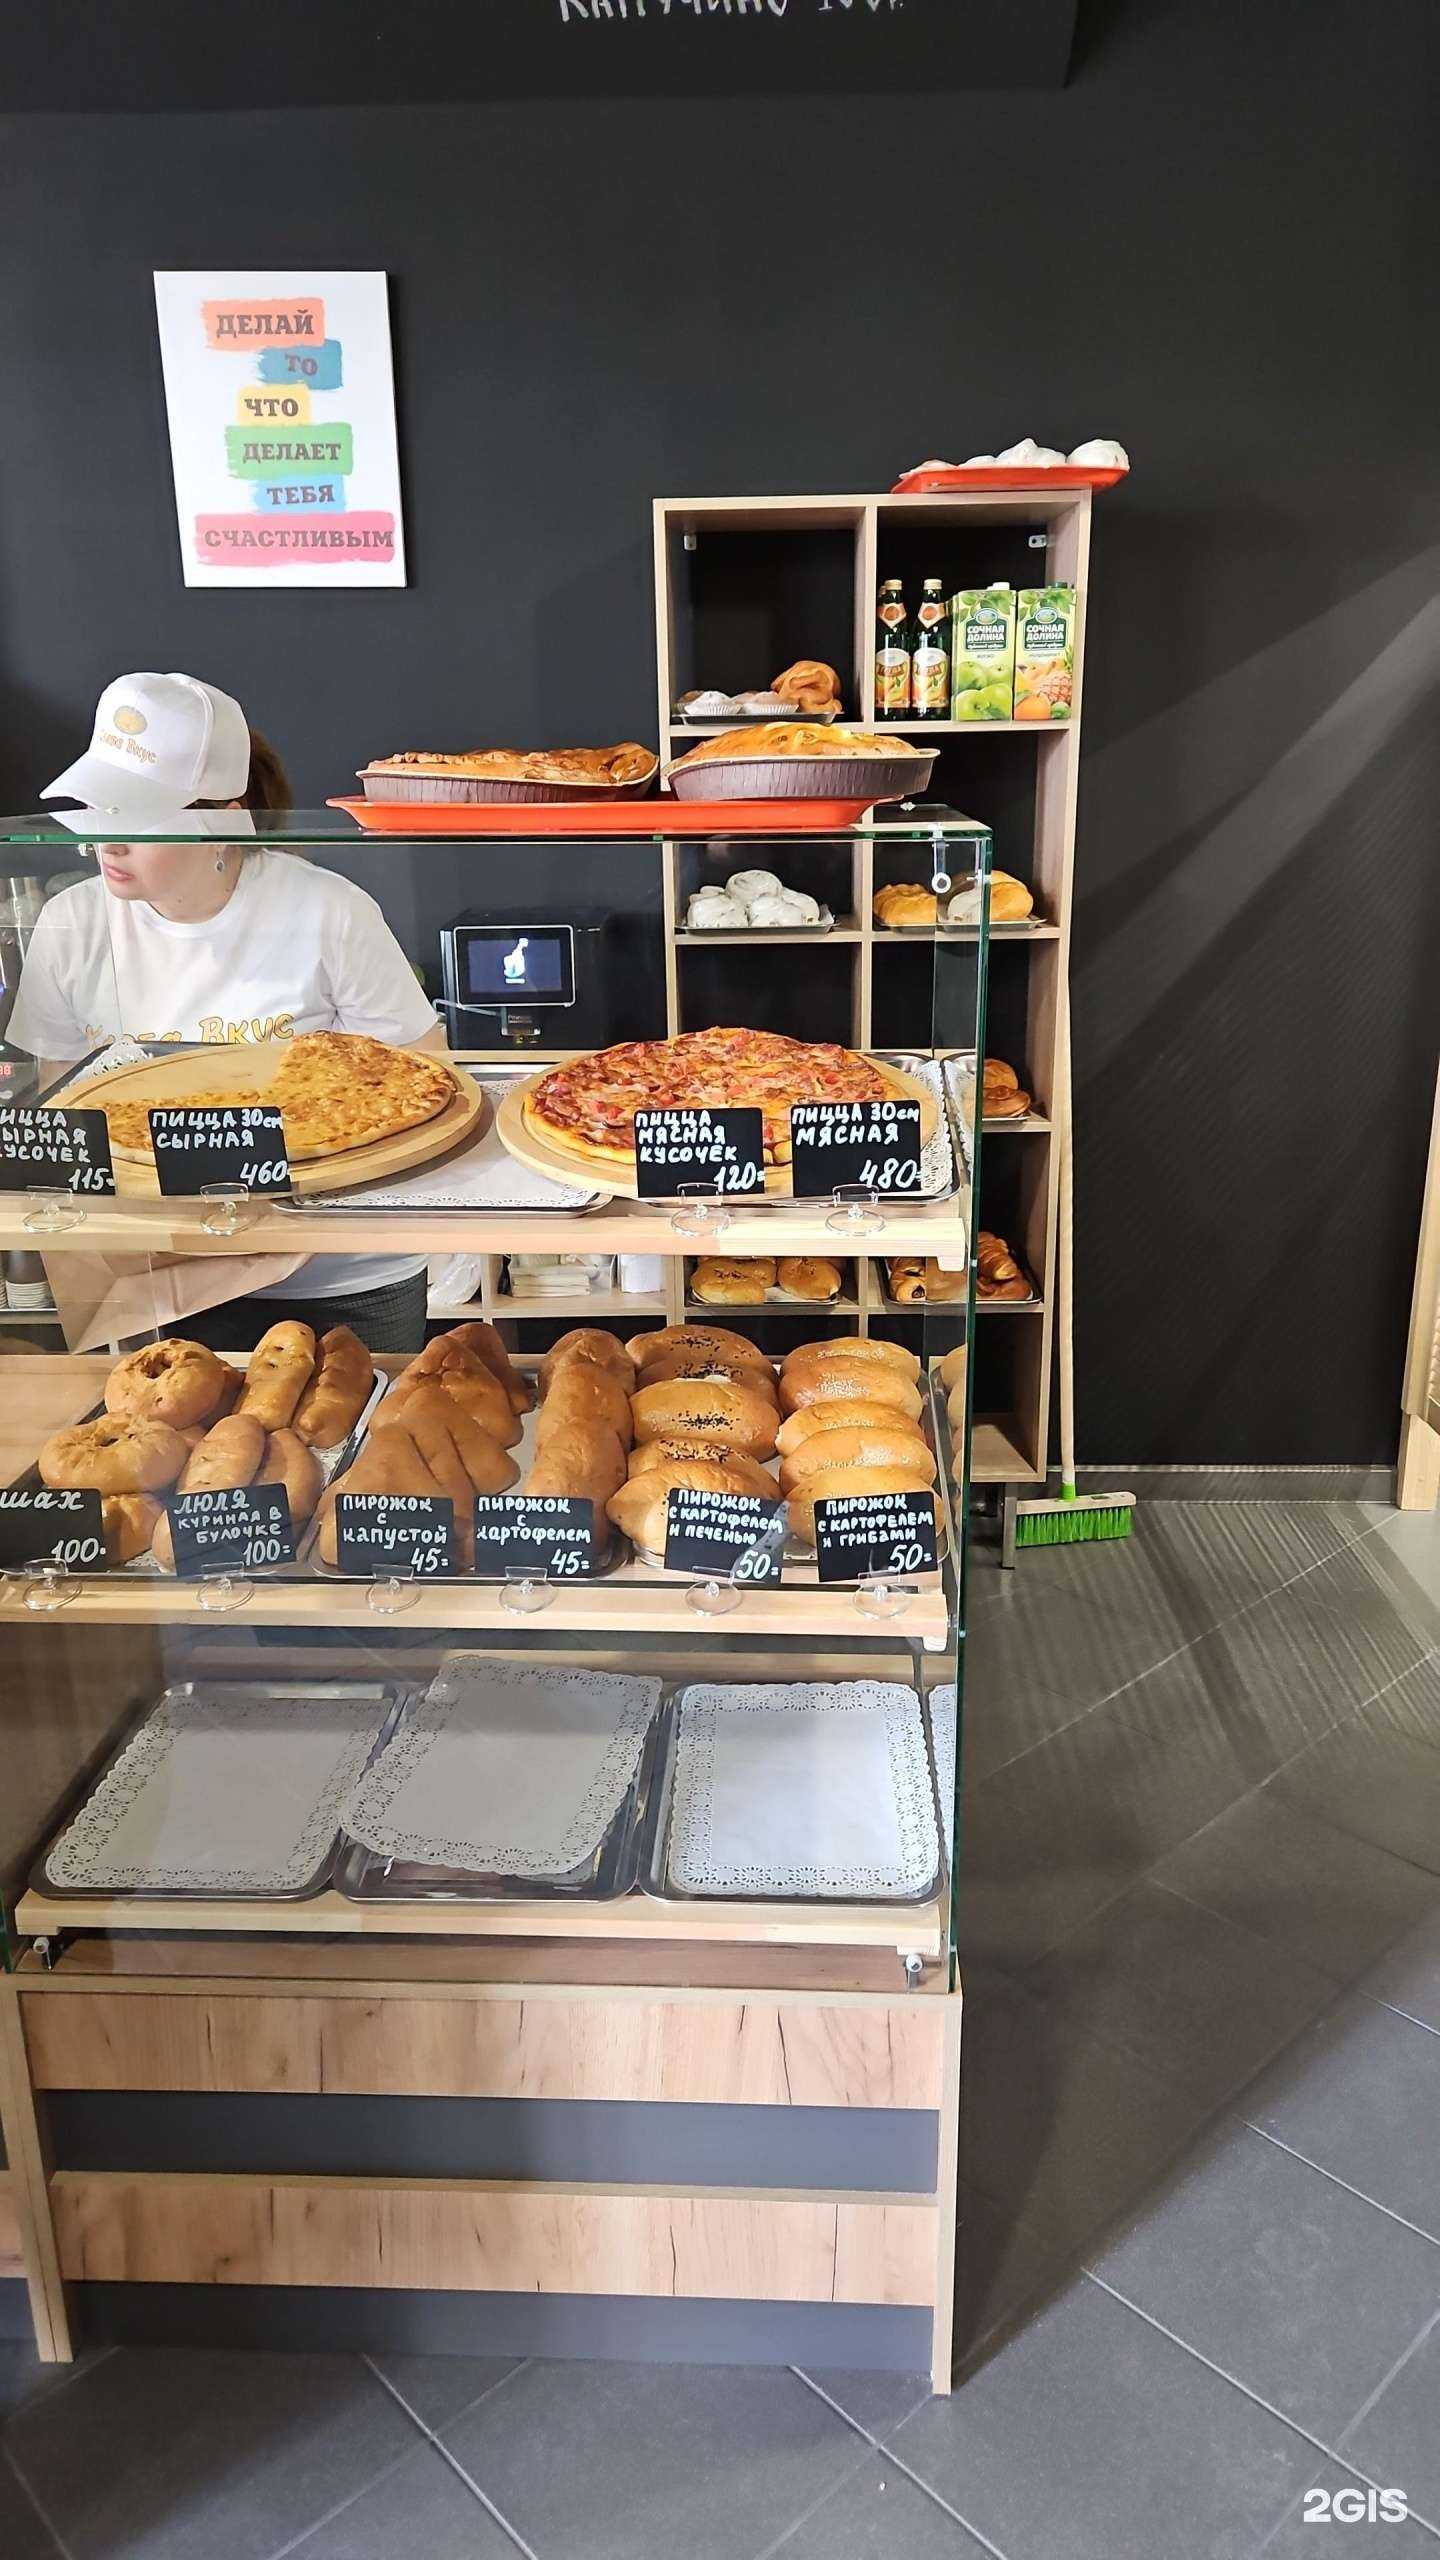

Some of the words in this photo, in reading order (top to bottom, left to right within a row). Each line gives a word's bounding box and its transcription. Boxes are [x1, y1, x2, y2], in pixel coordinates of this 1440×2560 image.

[216, 309, 314, 338] ДЕЛАЙ
[284, 354, 318, 376] ТО
[244, 398, 299, 417] ЧТО
[242, 443, 341, 464] ДЕЛАЕТ
[267, 485, 335, 505] ТЕБЯ
[204, 530, 393, 548] СЧАСТЛИВЫМ
[967, 625, 1005, 633] СОЧНАЯ
[967, 633, 1005, 641] ДОЛИНА
[1026, 624, 1064, 632] СОЧНАЯ
[1026, 632, 1064, 640] ДОЛИНА
[0, 1109, 67, 1128] ИЦЦА
[152, 1110, 237, 1130] ПИЦЦА
[636, 1110, 711, 1129] ПИЦЦА
[792, 1103, 862, 1126] ПИЦЦА
[1, 1127, 86, 1145] ЫРНАЯ
[156, 1129, 254, 1149] СЫРНАЯ
[638, 1125, 725, 1144] МЯСНАЯ
[796, 1122, 898, 1147] МЯСНАЯ
[0, 1144, 91, 1163] УСОЧЕК
[640, 1145, 737, 1164] КУСОЧЕК
[343, 1495, 432, 1512] ПИРОЖОК
[478, 1497, 570, 1513] ПИРОЖОК
[678, 1489, 760, 1512] ПИРОЖОК
[826, 1494, 907, 1516] ПИРОЖОК
[178, 1510, 260, 1529] КУРИНАЯ
[830, 1511, 933, 1532] КАРТОФЕЛЕМ
[343, 1525, 447, 1549] капустой
[685, 1524, 756, 1545] ПЕЧЕНЬЮ
